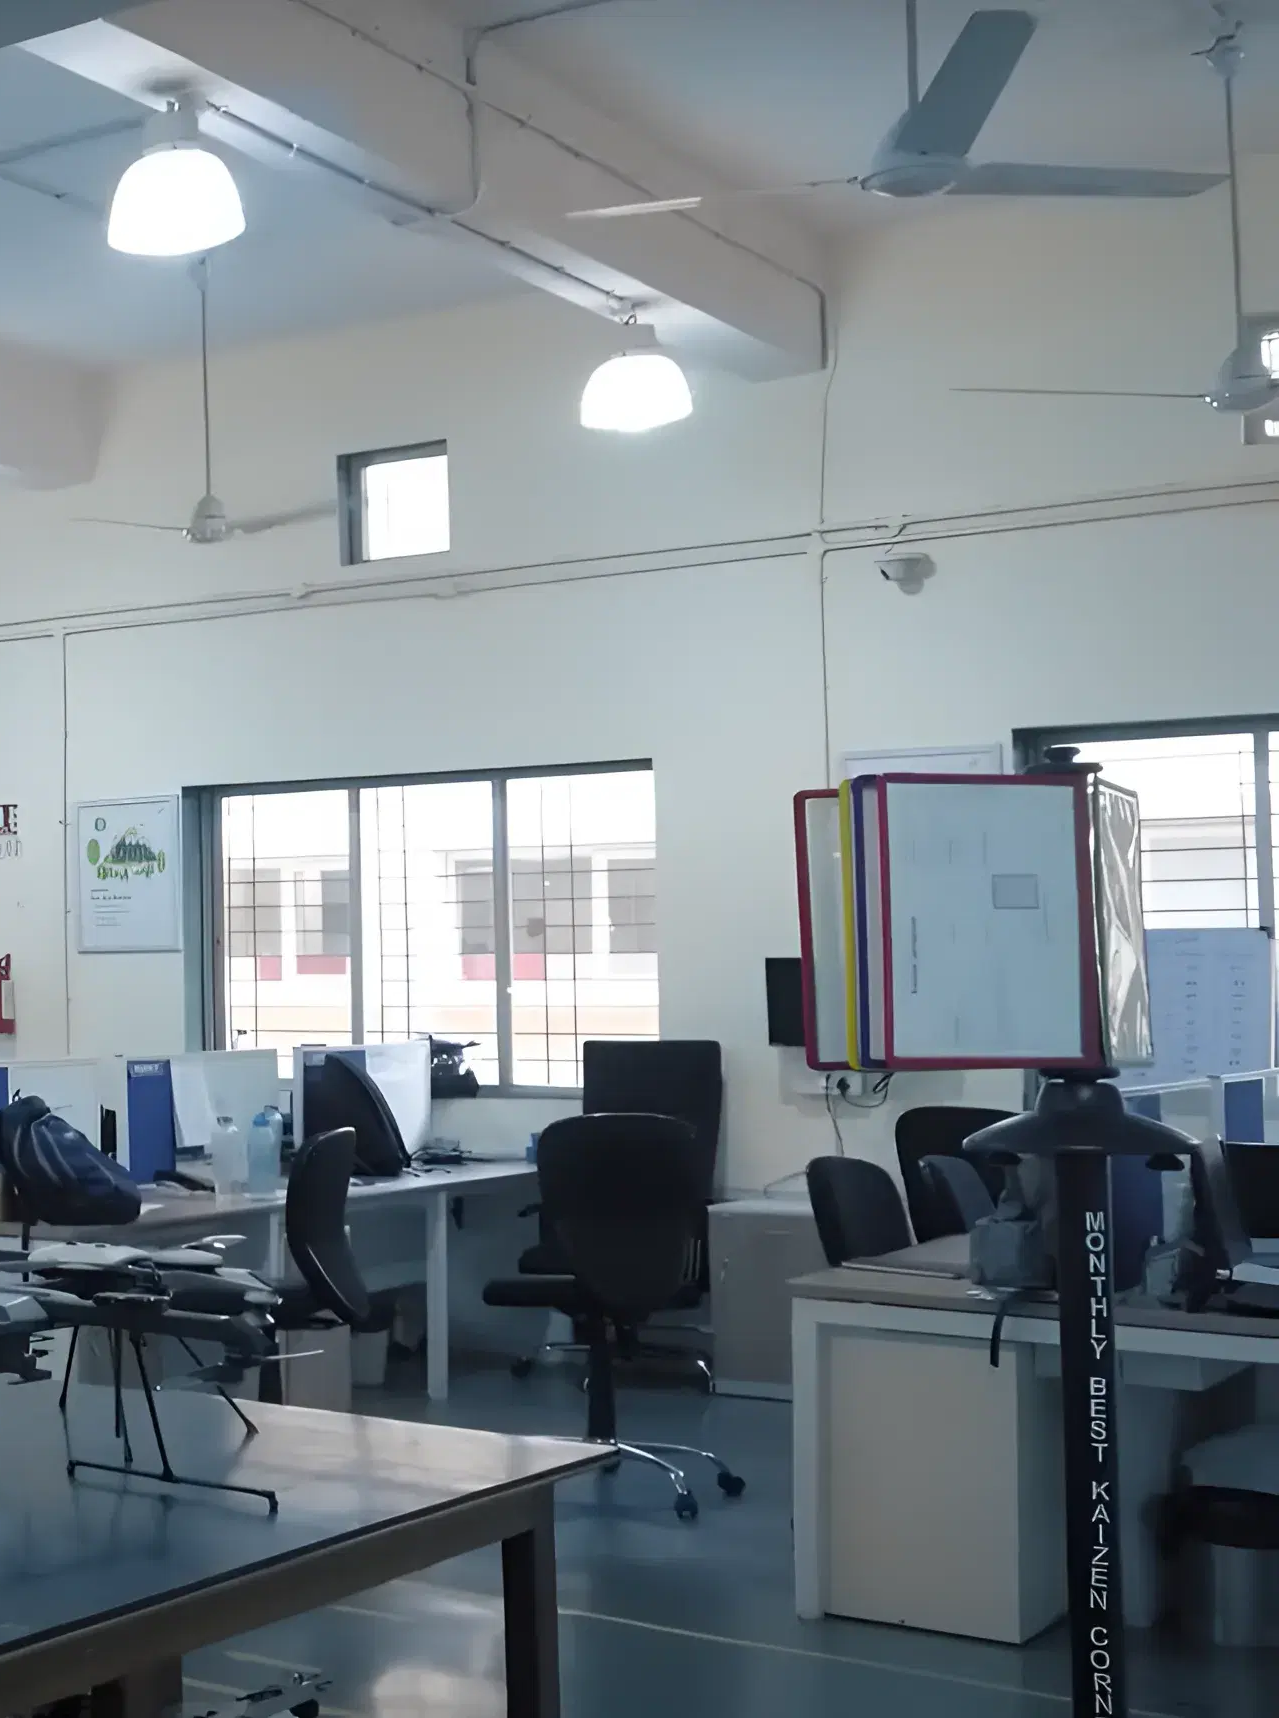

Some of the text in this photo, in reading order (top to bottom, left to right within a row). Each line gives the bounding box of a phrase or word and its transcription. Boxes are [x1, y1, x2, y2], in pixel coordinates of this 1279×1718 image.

[1085, 1211, 1113, 1718] MONTHLY BEST KAIZEN CORN
